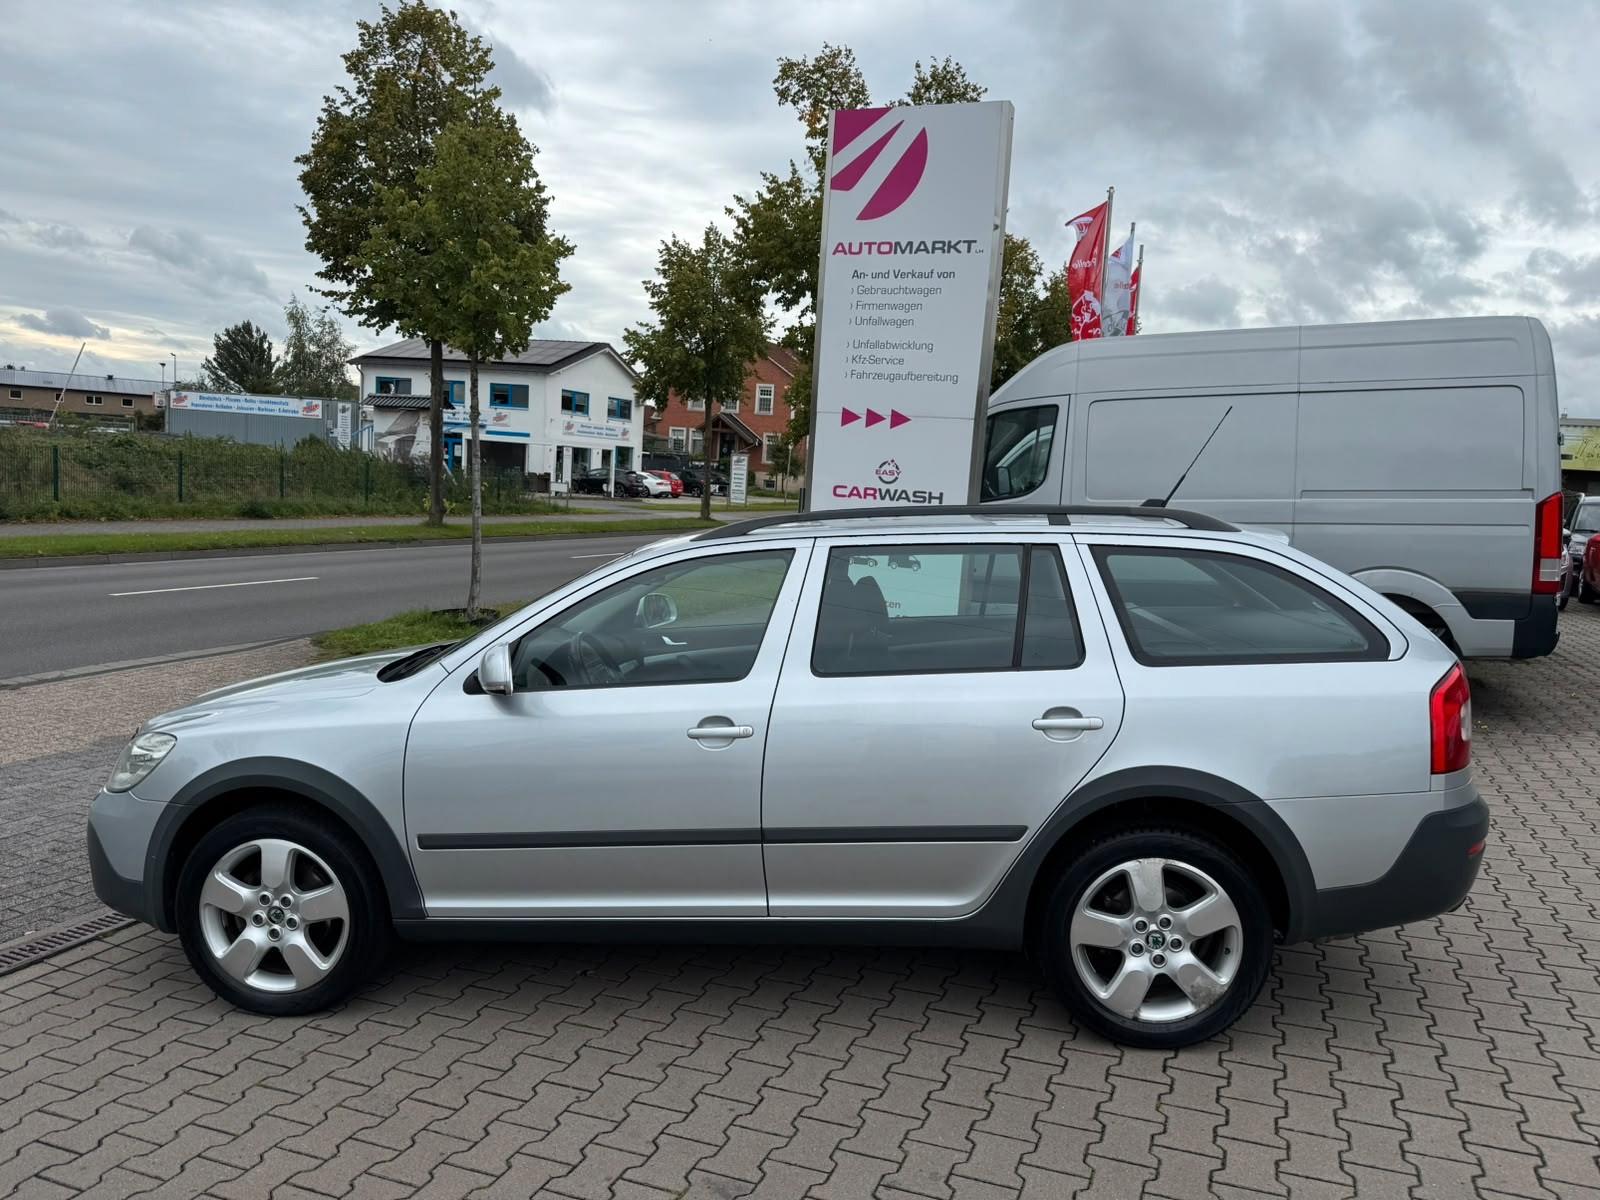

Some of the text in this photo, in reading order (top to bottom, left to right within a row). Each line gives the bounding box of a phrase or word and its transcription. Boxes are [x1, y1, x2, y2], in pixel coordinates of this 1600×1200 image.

[832, 239, 977, 256] AUTOMARKT
[851, 269, 956, 279] An- und Verkauf von
[856, 284, 942, 297] Gebrauchtwagen
[855, 300, 923, 313] Firmenwagen
[854, 316, 915, 329] Unfallwagen
[852, 339, 934, 352] Unfallabwicklung
[851, 355, 905, 366] Kfz-Service
[850, 369, 959, 384] Fahrzeugaufbereitung
[875, 468, 902, 477] EASY
[832, 484, 944, 505] CARWASH
